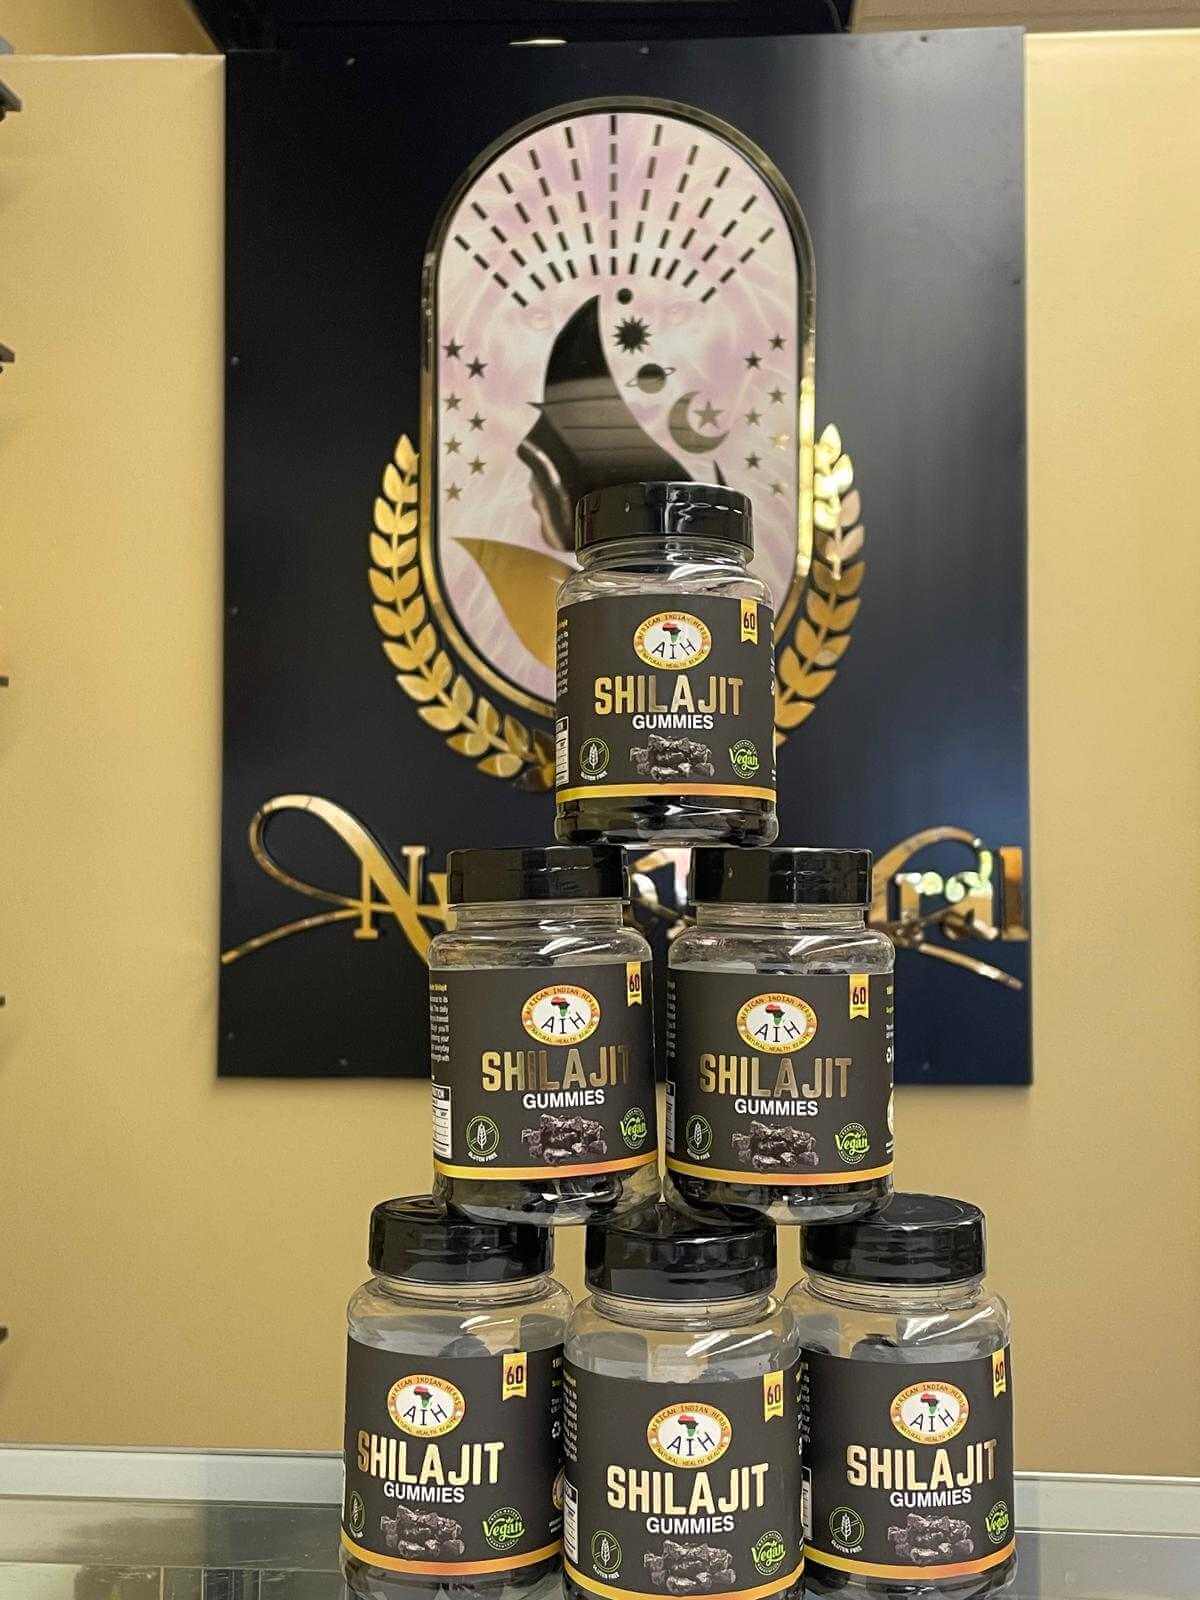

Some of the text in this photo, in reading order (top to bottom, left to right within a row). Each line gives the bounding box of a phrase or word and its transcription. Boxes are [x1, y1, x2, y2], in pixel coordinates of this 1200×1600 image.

[743, 612, 756, 629] 60
[652, 639, 696, 659] AIH
[594, 675, 744, 715] SHILAJIT
[632, 714, 714, 730] GUMMIES
[728, 747, 760, 771] Vegan
[629, 974, 640, 993] 60
[852, 986, 866, 1005] 60
[541, 1012, 586, 1034] AIH
[755, 1021, 801, 1043] AIH
[481, 1045, 632, 1092] SHILAJIT
[699, 1053, 852, 1099] SHILAJIT
[522, 1089, 605, 1109] GUMMIES
[734, 1098, 819, 1117] GUMMIES
[619, 1118, 649, 1140] Vegan
[834, 1132, 870, 1155] Vegan
[506, 1365, 523, 1385] 60
[994, 1363, 1004, 1383] 60
[767, 1384, 781, 1405] 60
[403, 1403, 447, 1426] AIH
[909, 1408, 955, 1432] AIH
[667, 1431, 716, 1456] AIH
[357, 1430, 504, 1486] SHILAJIT
[846, 1438, 997, 1491] SHILAJIT
[383, 1481, 465, 1503] GUMMIES
[607, 1462, 769, 1516] SHILAJIT
[889, 1487, 972, 1508] GUMMIES
[482, 1517, 527, 1542] Vegan
[646, 1515, 735, 1535] GUMMIES
[751, 1542, 786, 1566] Vegan
